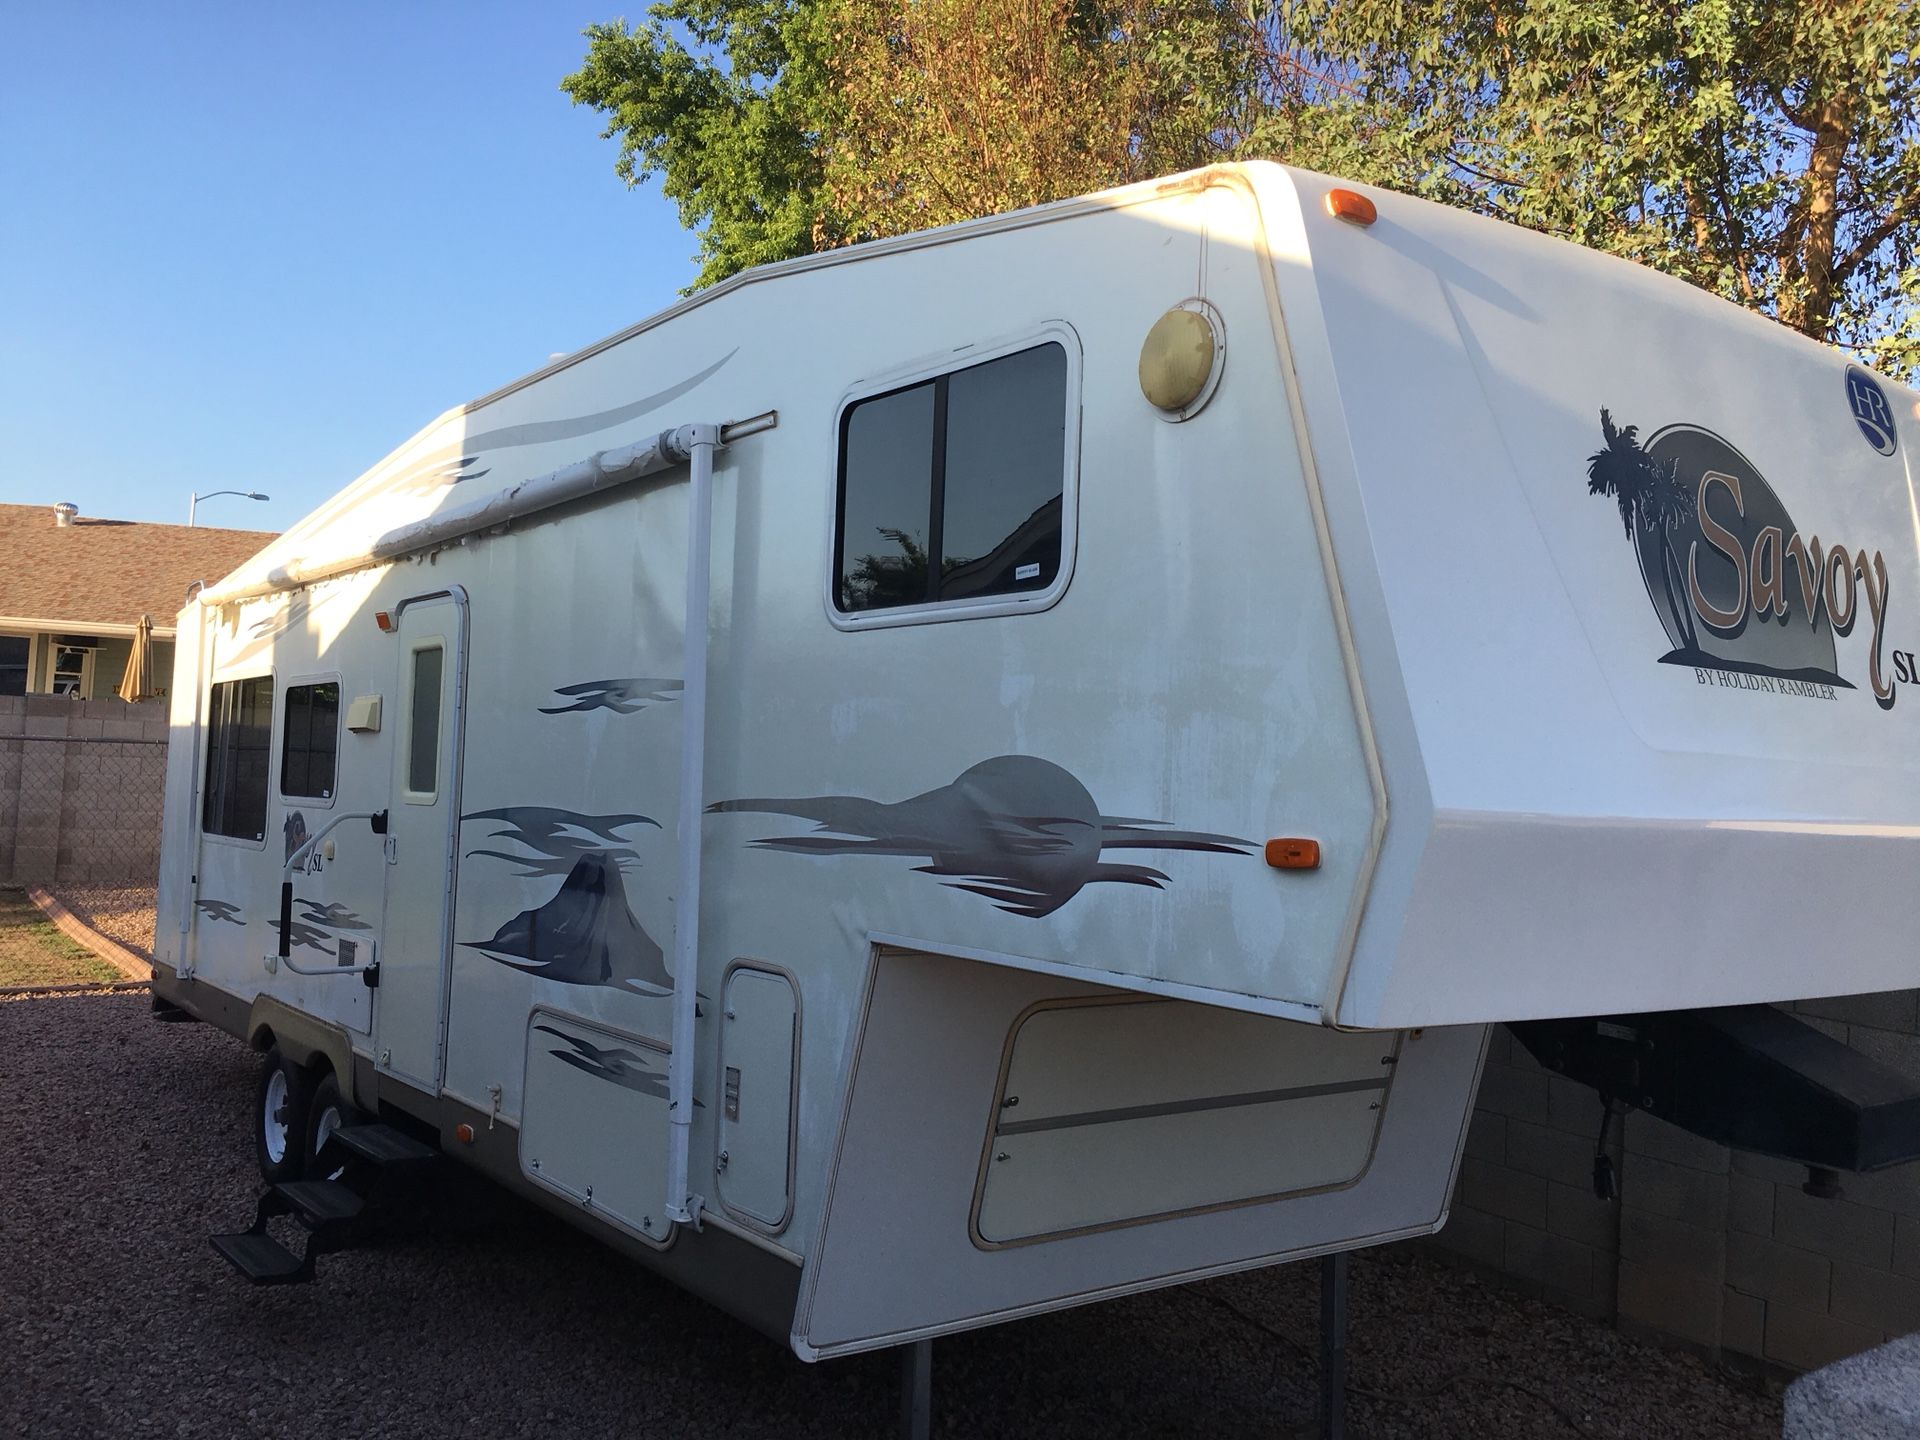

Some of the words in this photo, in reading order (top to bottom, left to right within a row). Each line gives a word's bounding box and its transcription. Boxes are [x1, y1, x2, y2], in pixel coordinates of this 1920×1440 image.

[1851, 380, 1890, 427] HR
[1688, 470, 1895, 710] Savoy
[1892, 649, 1920, 685] SL
[1694, 668, 1714, 686] BY
[1716, 671, 1776, 693] HOLIDAY
[1777, 678, 1838, 701] RAMBLER
[312, 853, 323, 872] SL
